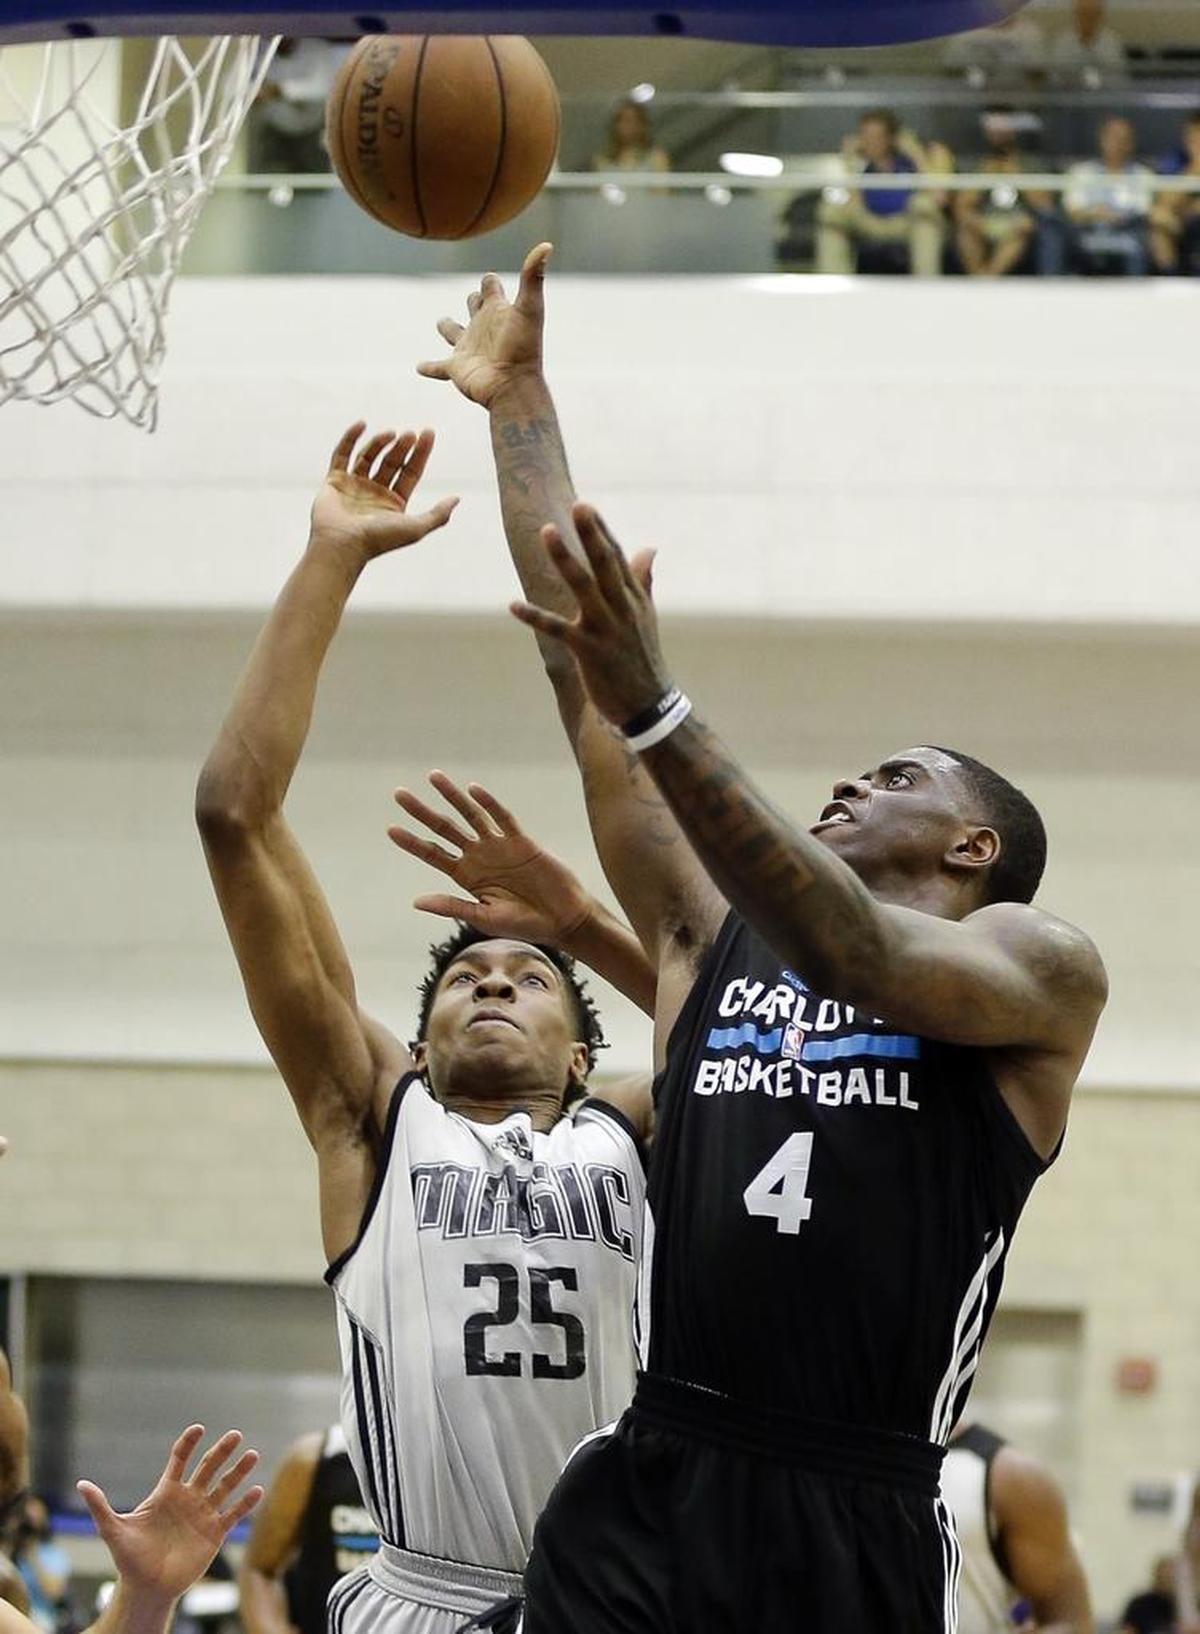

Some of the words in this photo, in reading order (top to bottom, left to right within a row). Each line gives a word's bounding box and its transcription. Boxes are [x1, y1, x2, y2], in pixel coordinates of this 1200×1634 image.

[717, 976, 885, 1032] CHARLO
[693, 1055, 919, 1111] BASKETBALL
[411, 1161, 635, 1263] MAGIC
[743, 1131, 814, 1236] 4
[463, 1263, 586, 1380] 25
